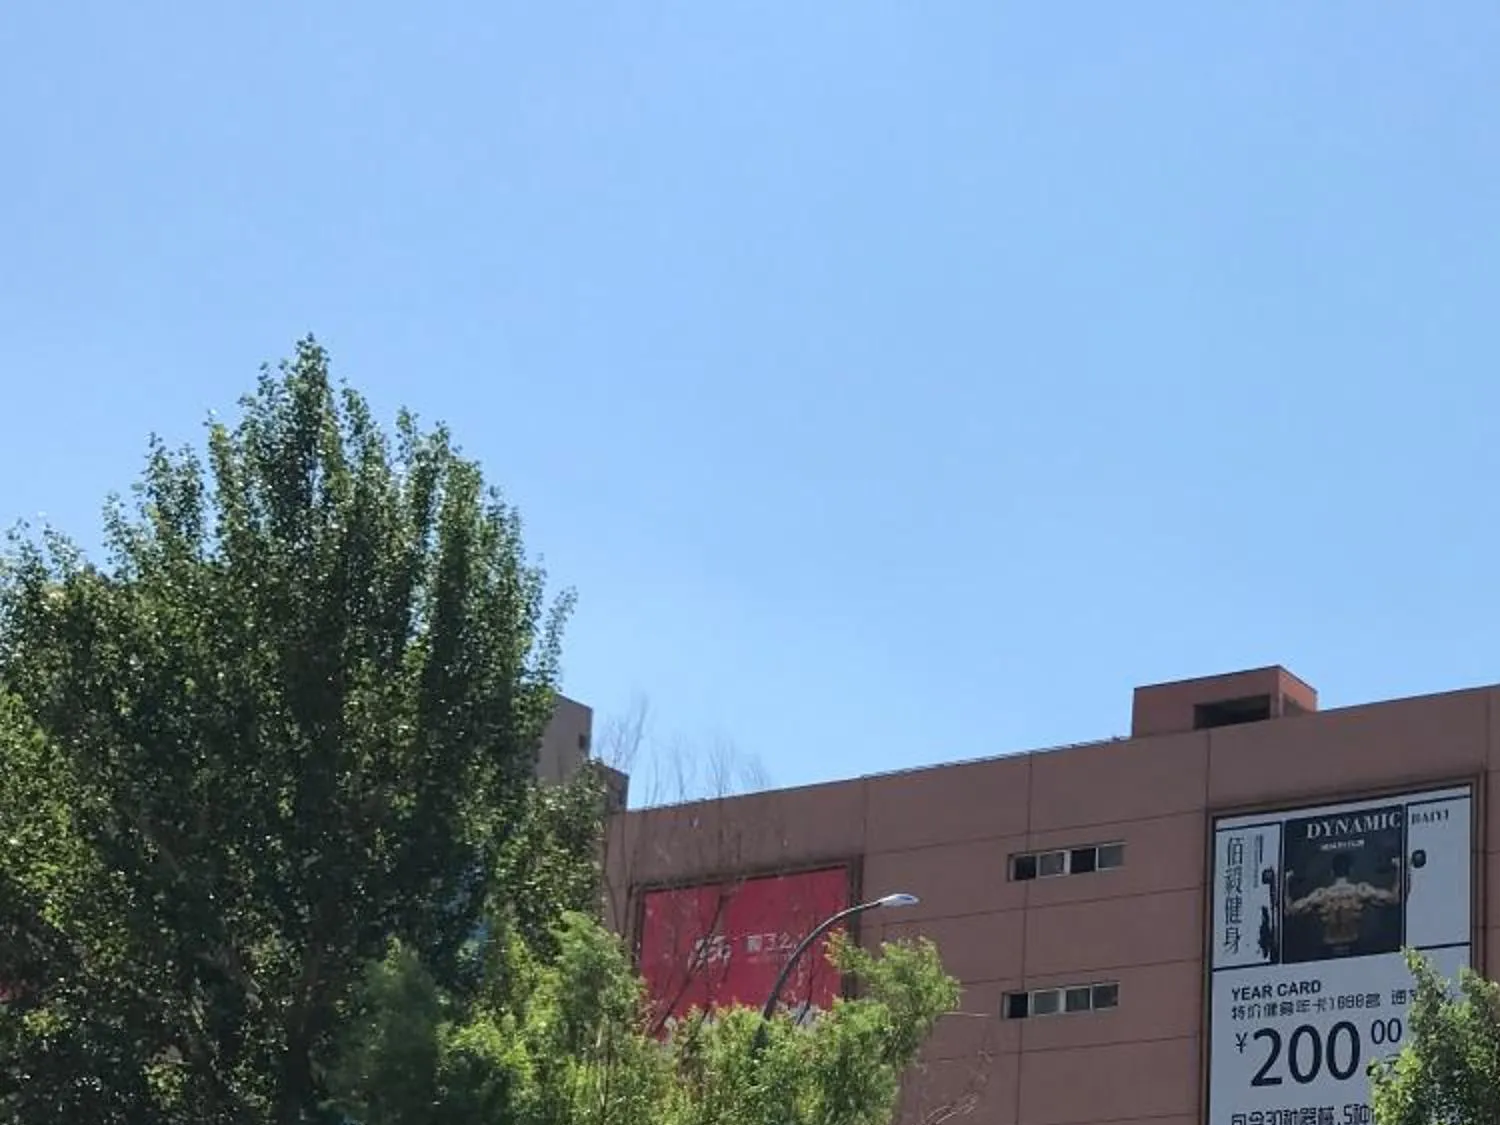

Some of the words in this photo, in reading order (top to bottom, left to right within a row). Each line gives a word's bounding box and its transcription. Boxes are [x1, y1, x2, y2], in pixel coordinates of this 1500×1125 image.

[1306, 811, 1402, 839] DYNAMIC
[1231, 985, 1273, 1002] YEAR
[1276, 979, 1321, 997] CARD
